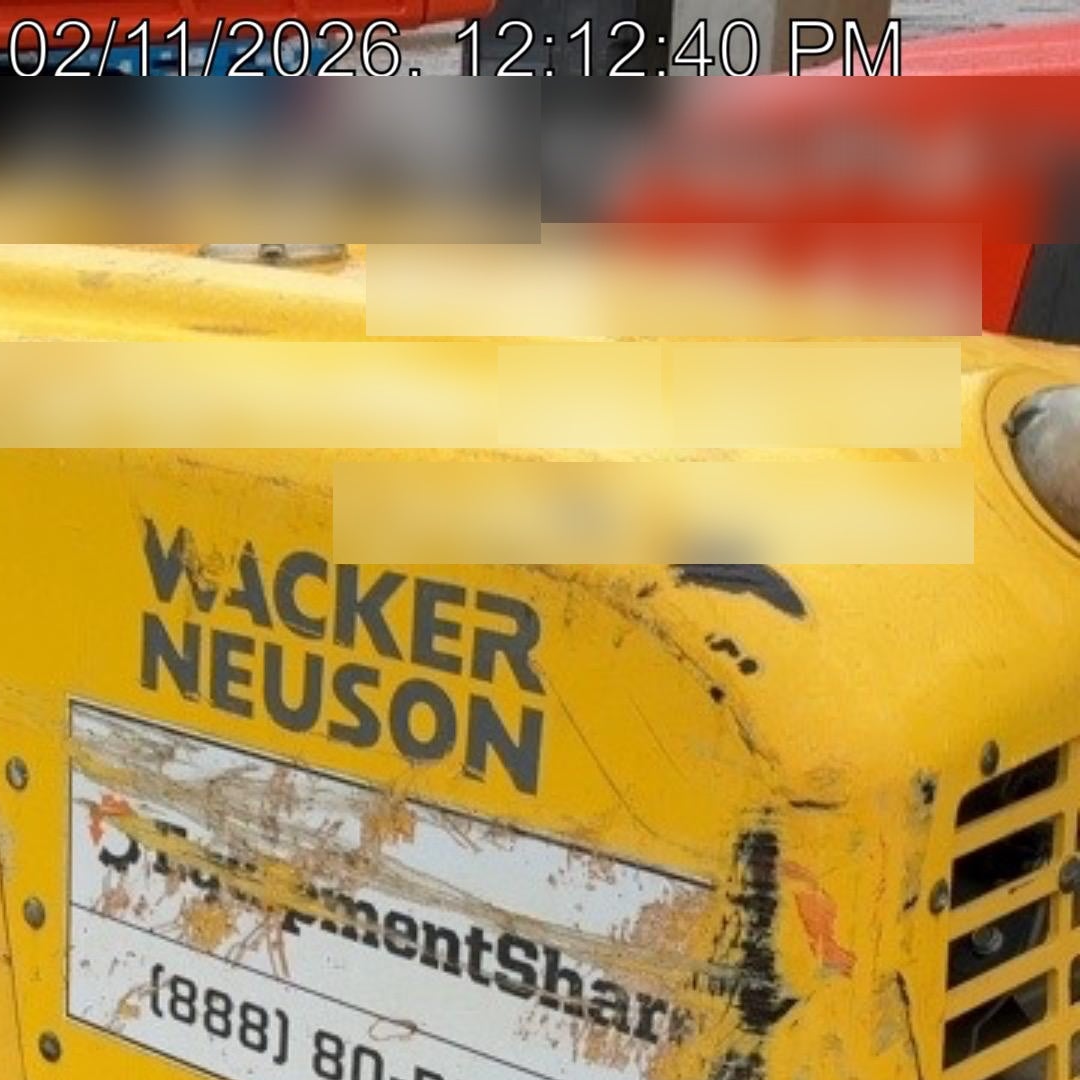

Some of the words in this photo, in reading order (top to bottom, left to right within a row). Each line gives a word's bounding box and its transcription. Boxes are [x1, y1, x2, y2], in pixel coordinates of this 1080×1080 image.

[142, 516, 546, 695] WACKER
[140, 611, 544, 796] NEUSON
[150, 963, 290, 1065] (888)
[152, 819, 696, 1046] mentShar
